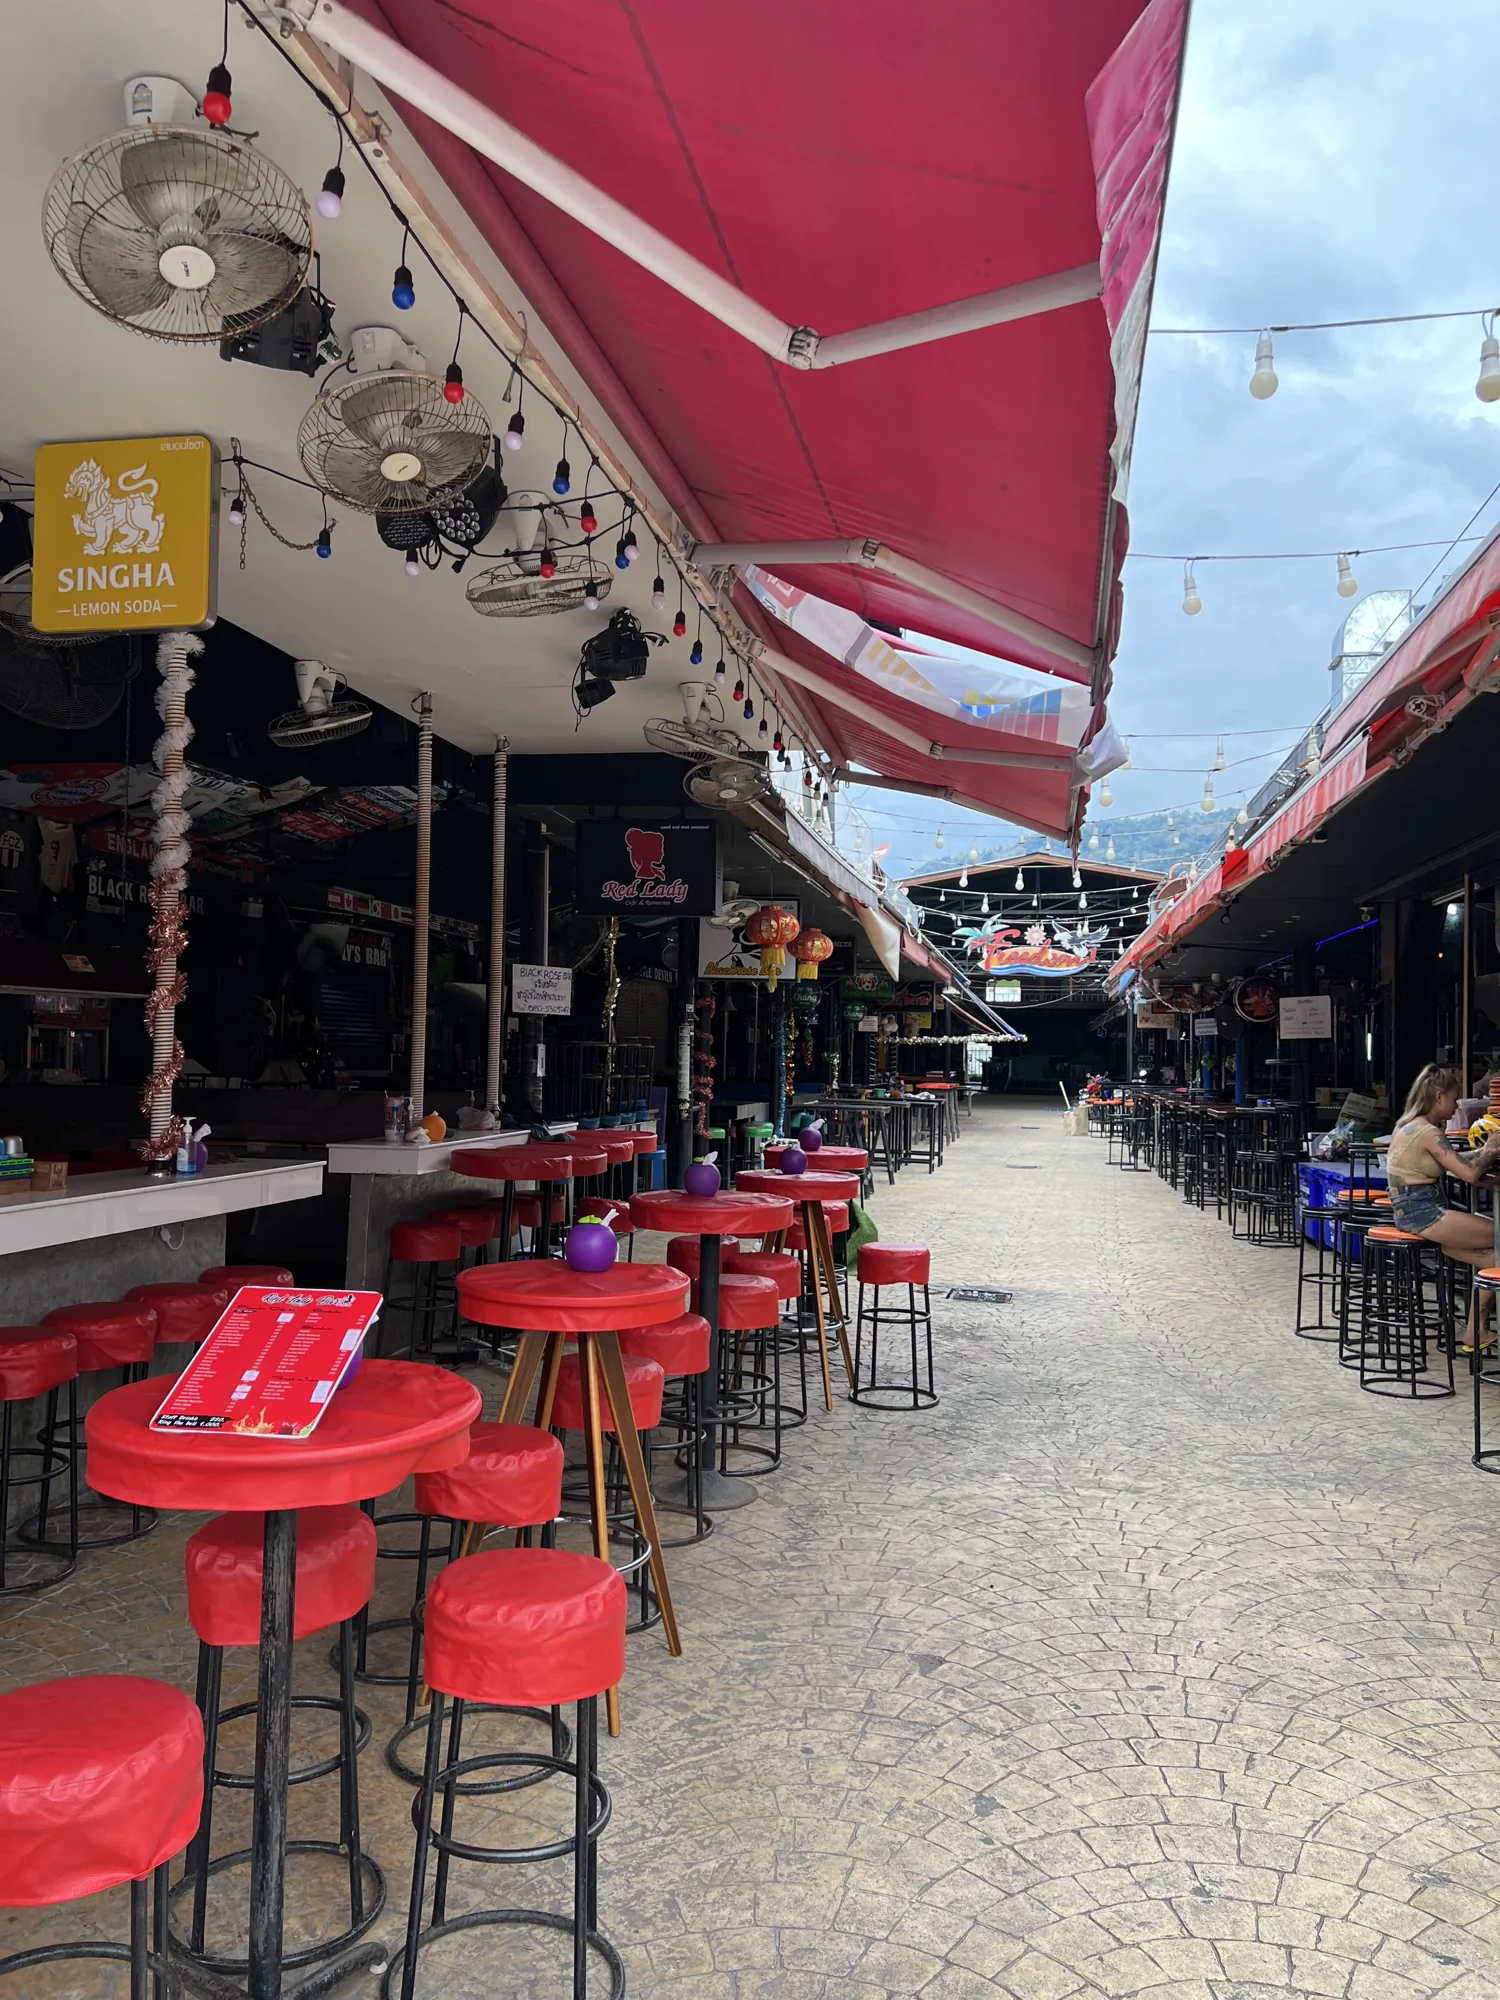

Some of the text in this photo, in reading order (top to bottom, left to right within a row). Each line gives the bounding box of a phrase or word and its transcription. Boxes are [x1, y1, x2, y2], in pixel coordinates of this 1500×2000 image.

[57, 562, 175, 592] SINGHA
[73, 599, 161, 616] LEMON SODA
[2, 834, 22, 850] FCZ
[107, 834, 160, 859] ENGLAN
[88, 874, 134, 902] BLACK
[601, 878, 689, 904] Red Lady
[365, 947, 387, 967] BAR
[984, 929, 1097, 971] Freedom 1
[654, 967, 673, 983] DEVILS
[704, 961, 782, 976] Blackrose Br
[793, 992, 818, 1003] Chang
[844, 1010, 864, 1019] Chang
[261, 1292, 289, 1304] Red
[286, 1293, 314, 1307] Lady
